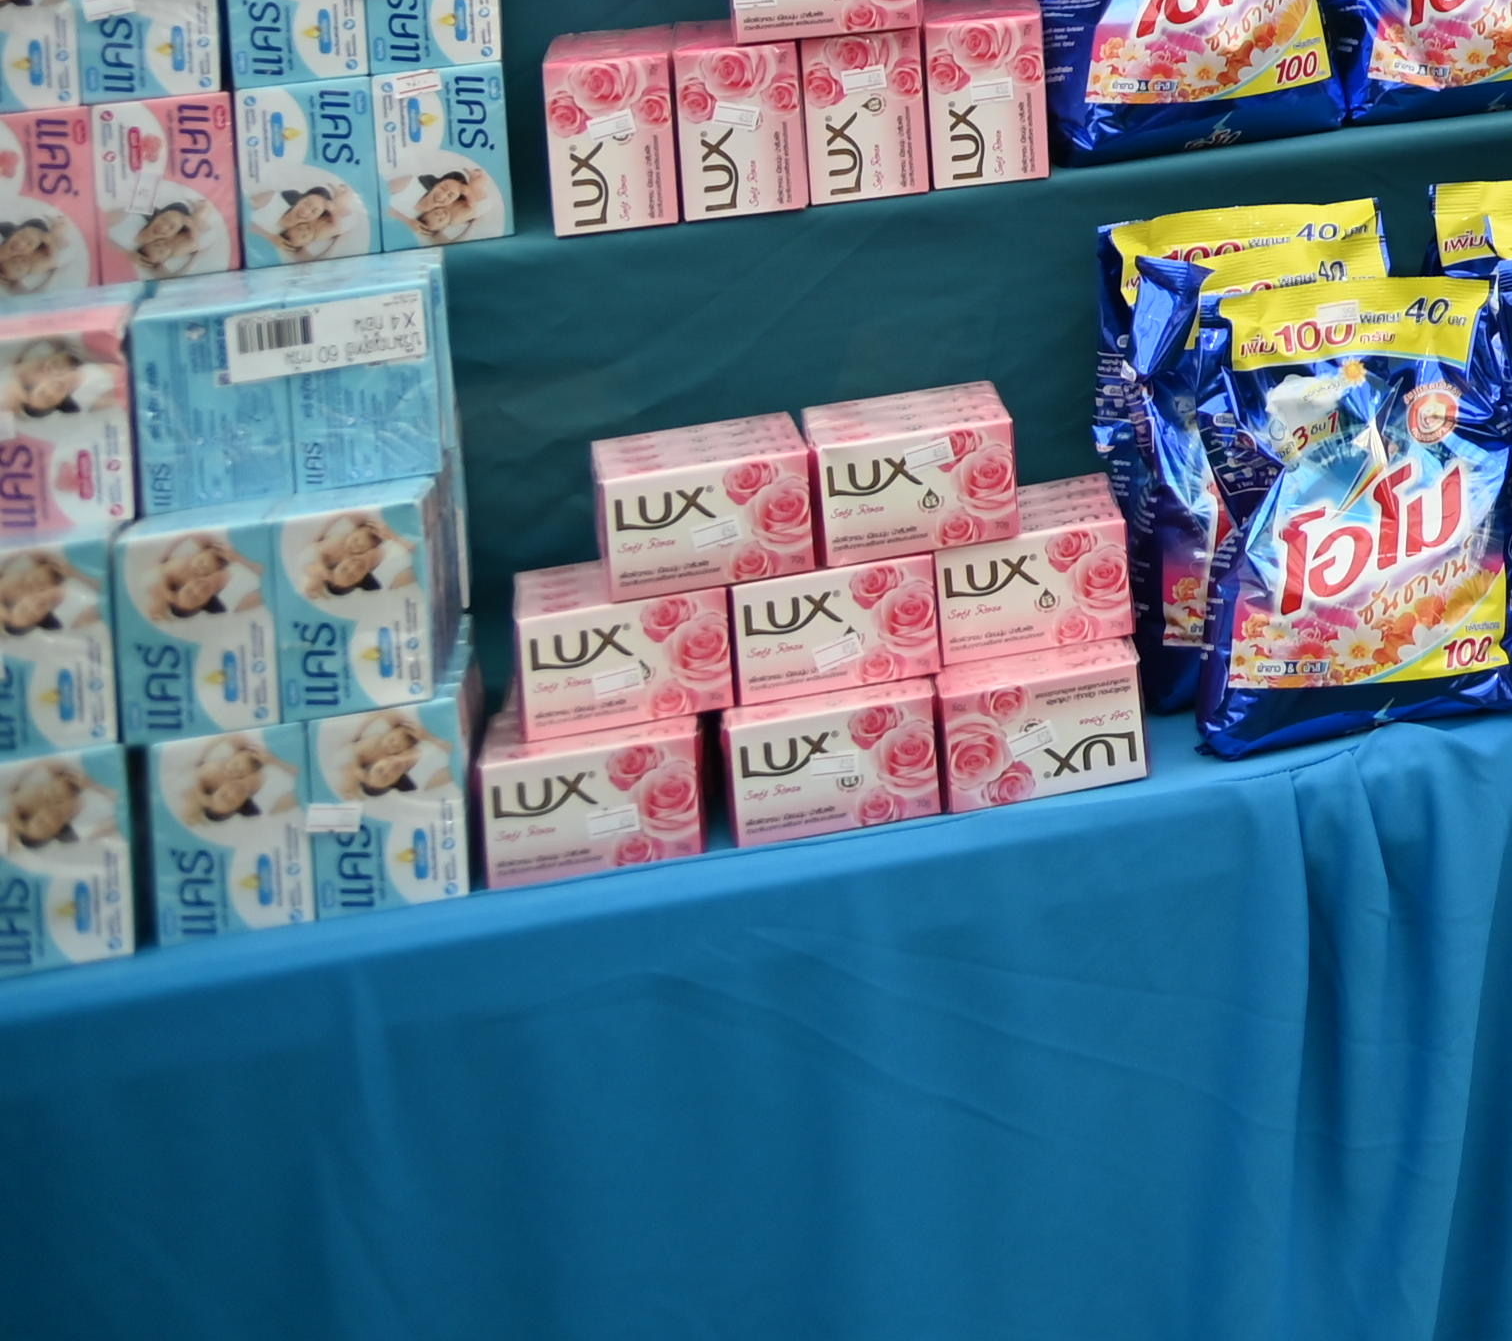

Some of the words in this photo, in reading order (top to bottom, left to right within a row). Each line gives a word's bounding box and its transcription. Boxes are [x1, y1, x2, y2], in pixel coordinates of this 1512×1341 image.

[573, 140, 609, 227] LUX
[704, 126, 740, 212] LUX
[825, 111, 863, 196] LUX
[949, 103, 985, 181] LUX
[317, 344, 339, 364] 60
[614, 484, 717, 532] LUX
[1279, 457, 1463, 616] โอโม
